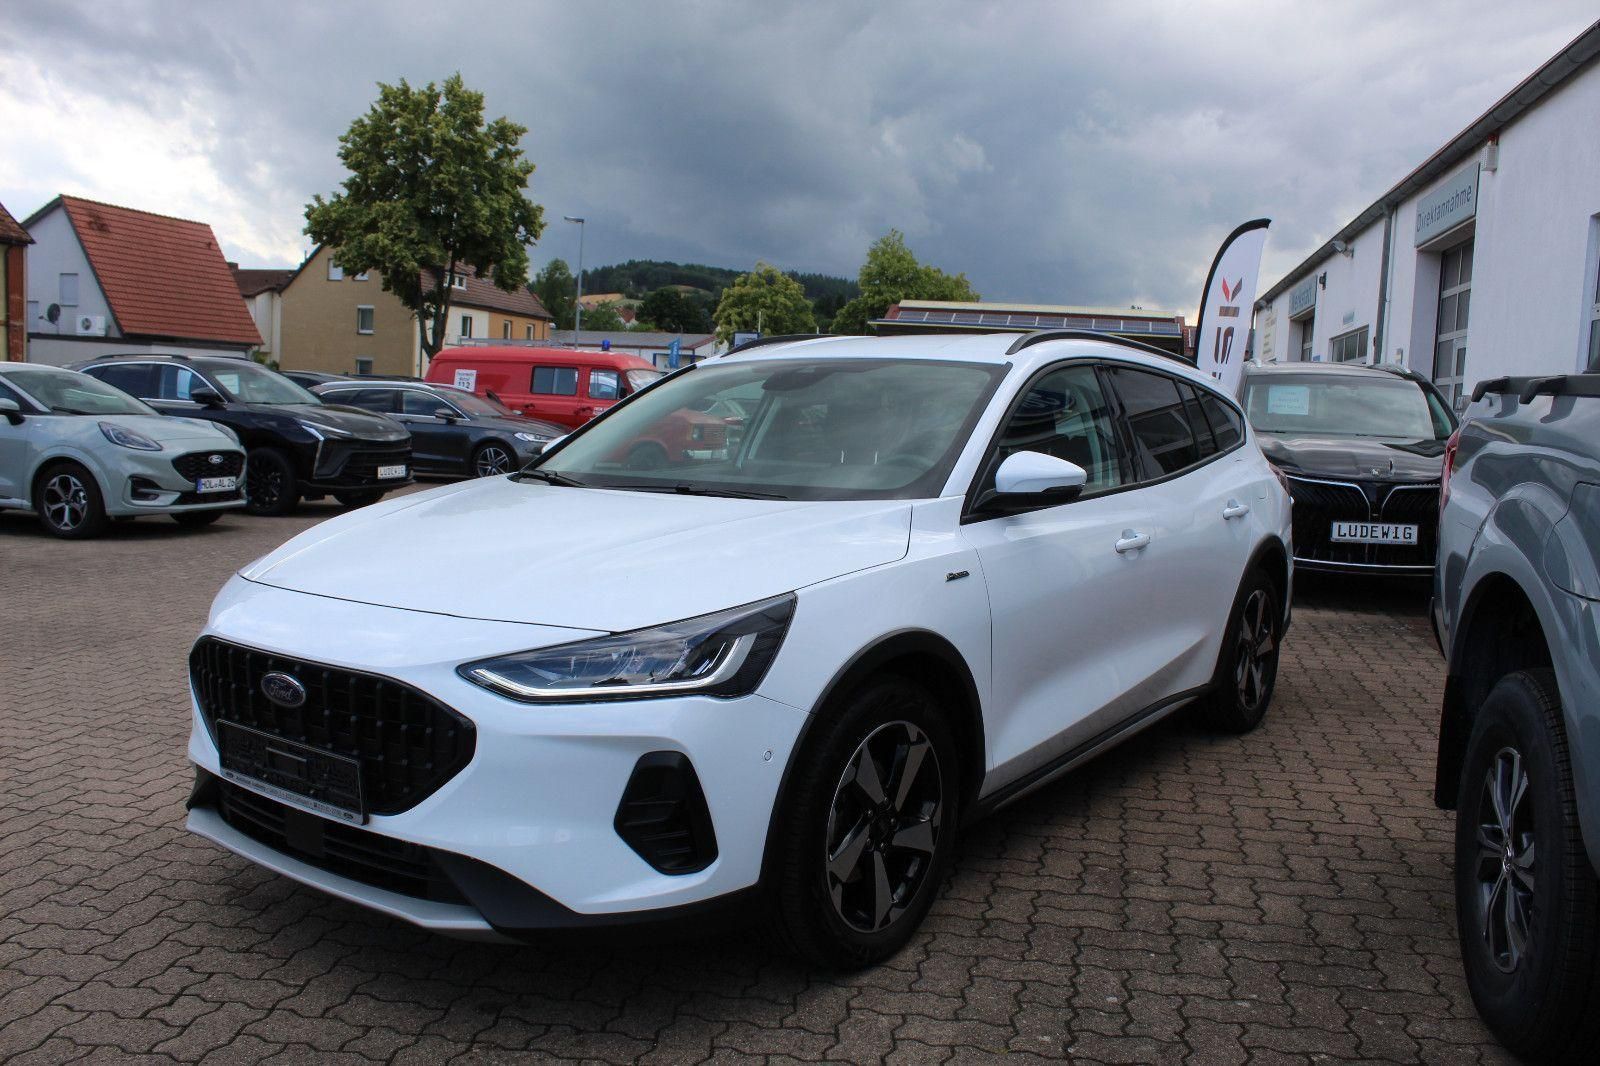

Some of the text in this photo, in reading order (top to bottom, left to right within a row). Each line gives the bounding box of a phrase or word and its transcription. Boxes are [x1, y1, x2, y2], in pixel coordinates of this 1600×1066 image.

[1416, 185, 1472, 233] Direktannahme
[458, 381, 471, 389] 112
[1337, 524, 1412, 540] LUDEWIG
